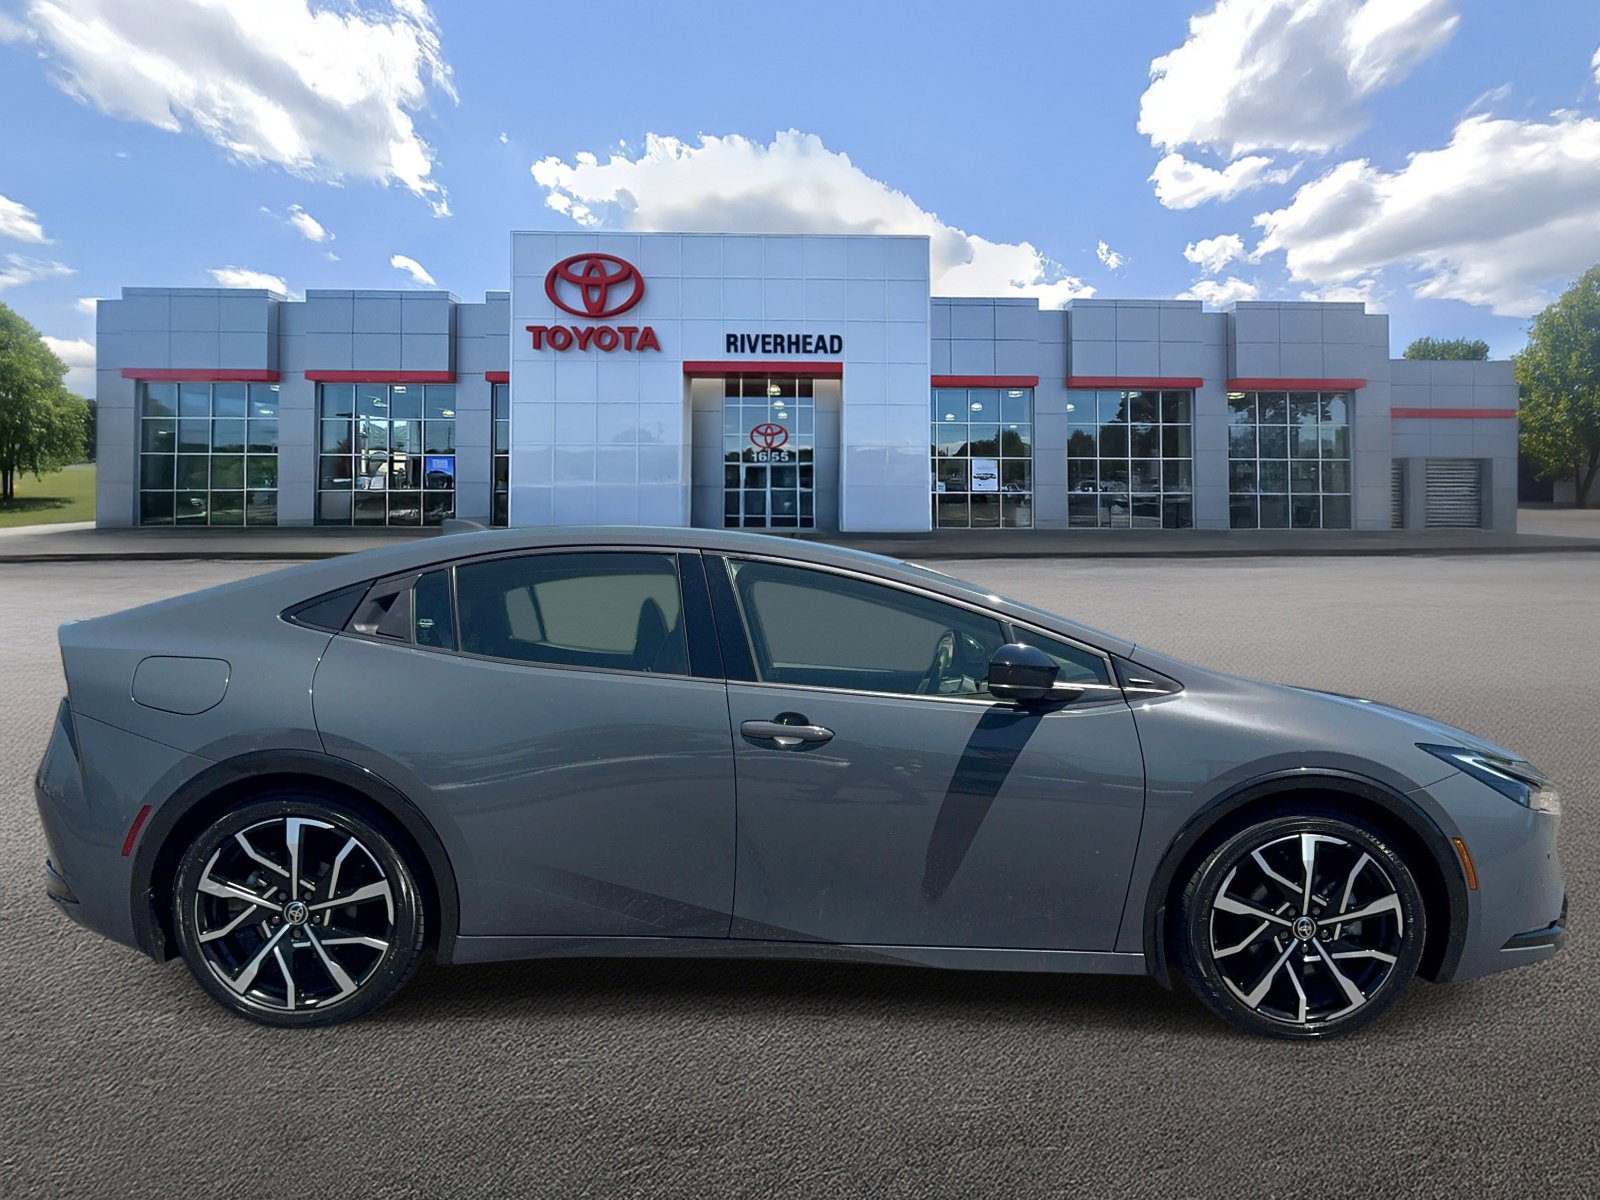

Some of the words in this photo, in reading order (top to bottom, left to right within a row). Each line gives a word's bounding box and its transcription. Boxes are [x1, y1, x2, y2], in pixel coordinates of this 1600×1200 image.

[525, 325, 661, 352] TOYOTA
[726, 333, 843, 354] RIVERHEAD
[752, 452, 789, 462] 1655
